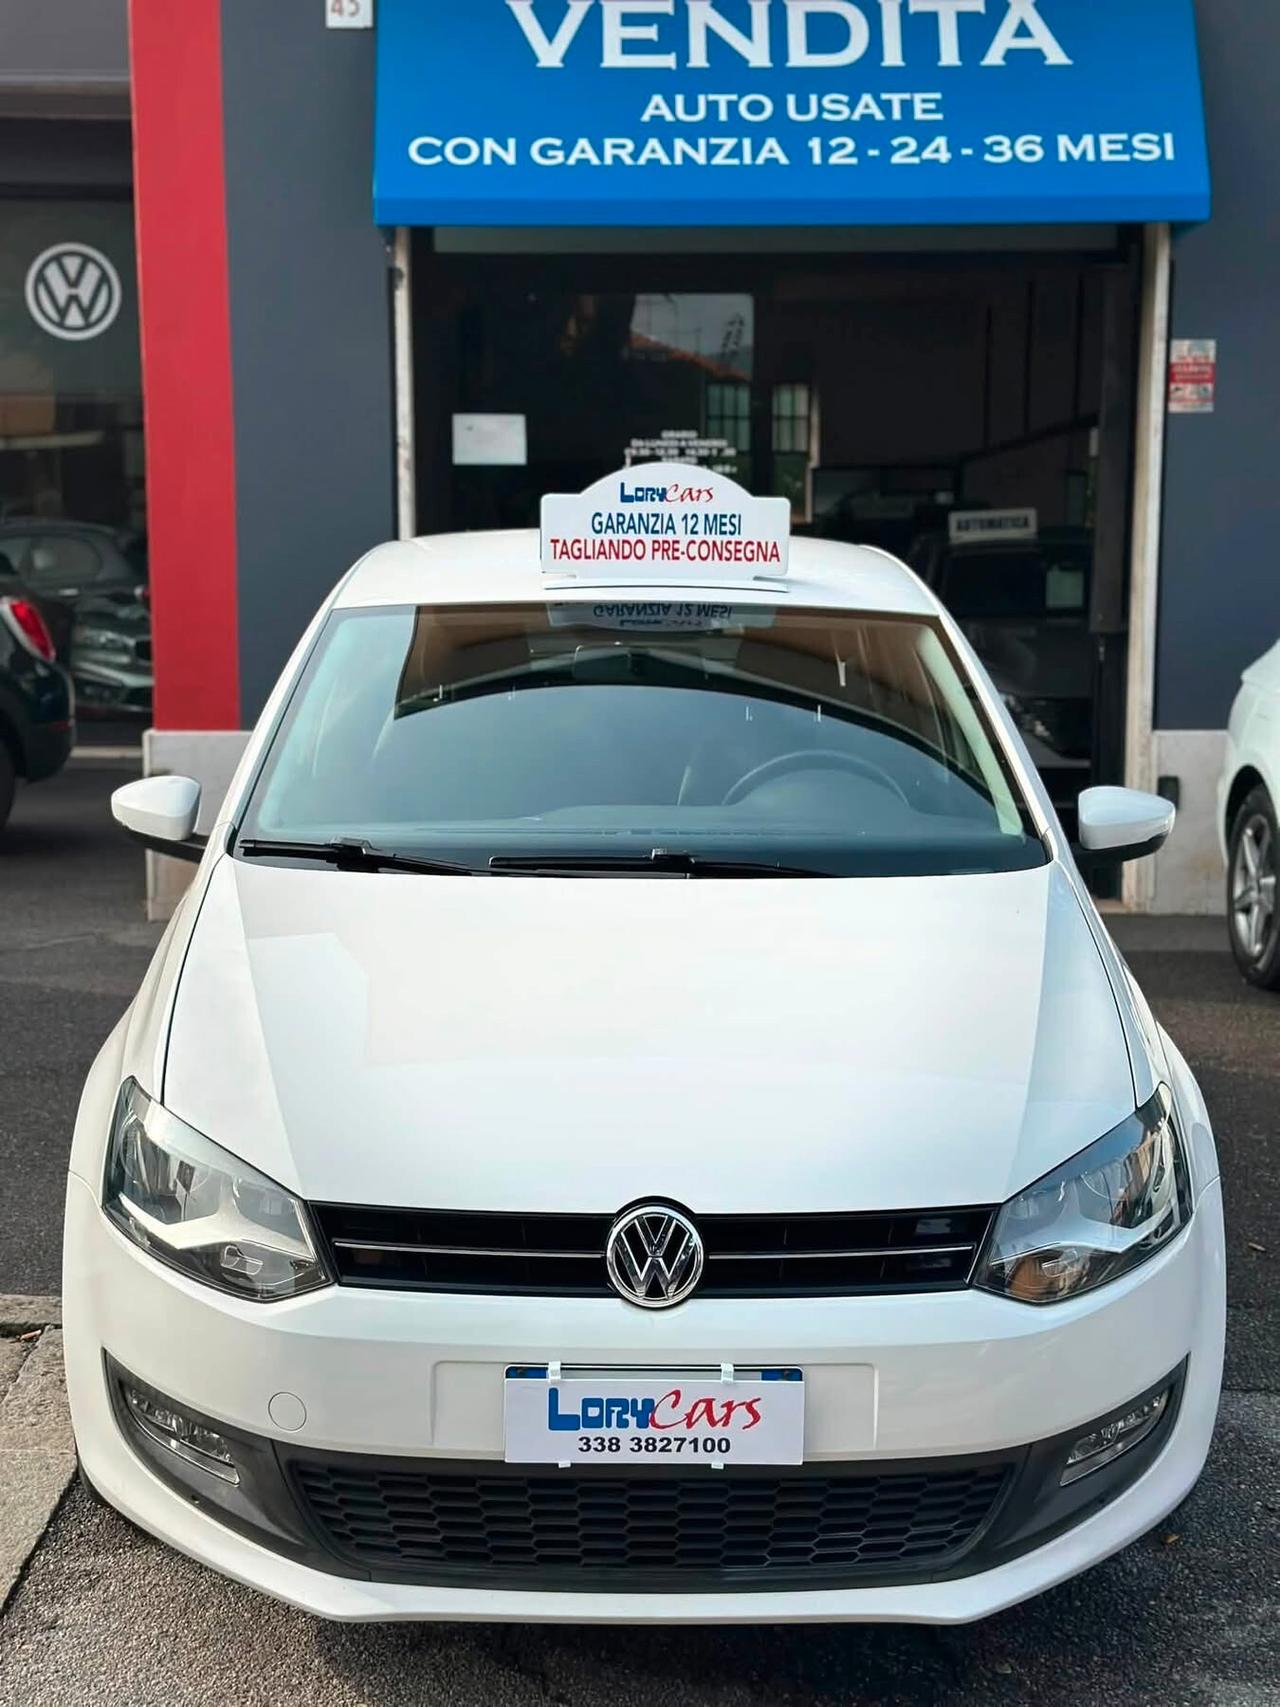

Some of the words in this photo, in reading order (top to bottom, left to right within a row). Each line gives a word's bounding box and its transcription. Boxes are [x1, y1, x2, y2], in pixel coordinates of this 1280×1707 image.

[507, 0, 1072, 69] VENDITA
[641, 93, 774, 122] AUTO
[787, 92, 943, 121] USATE
[409, 136, 516, 166] CON
[530, 136, 788, 166] GARANZIA
[809, 136, 858, 164] 12
[891, 136, 951, 163] 24
[984, 135, 1044, 163] 36
[1058, 132, 1174, 161] MESI
[591, 511, 677, 536] GARANZIA
[681, 512, 699, 536] 12
[703, 513, 742, 536] MESI
[550, 539, 646, 561] TAGLIANDO
[651, 540, 781, 562] PRE-CONSEGNA
[578, 1436, 621, 1453] 338
[629, 1436, 731, 1454] 3827100
